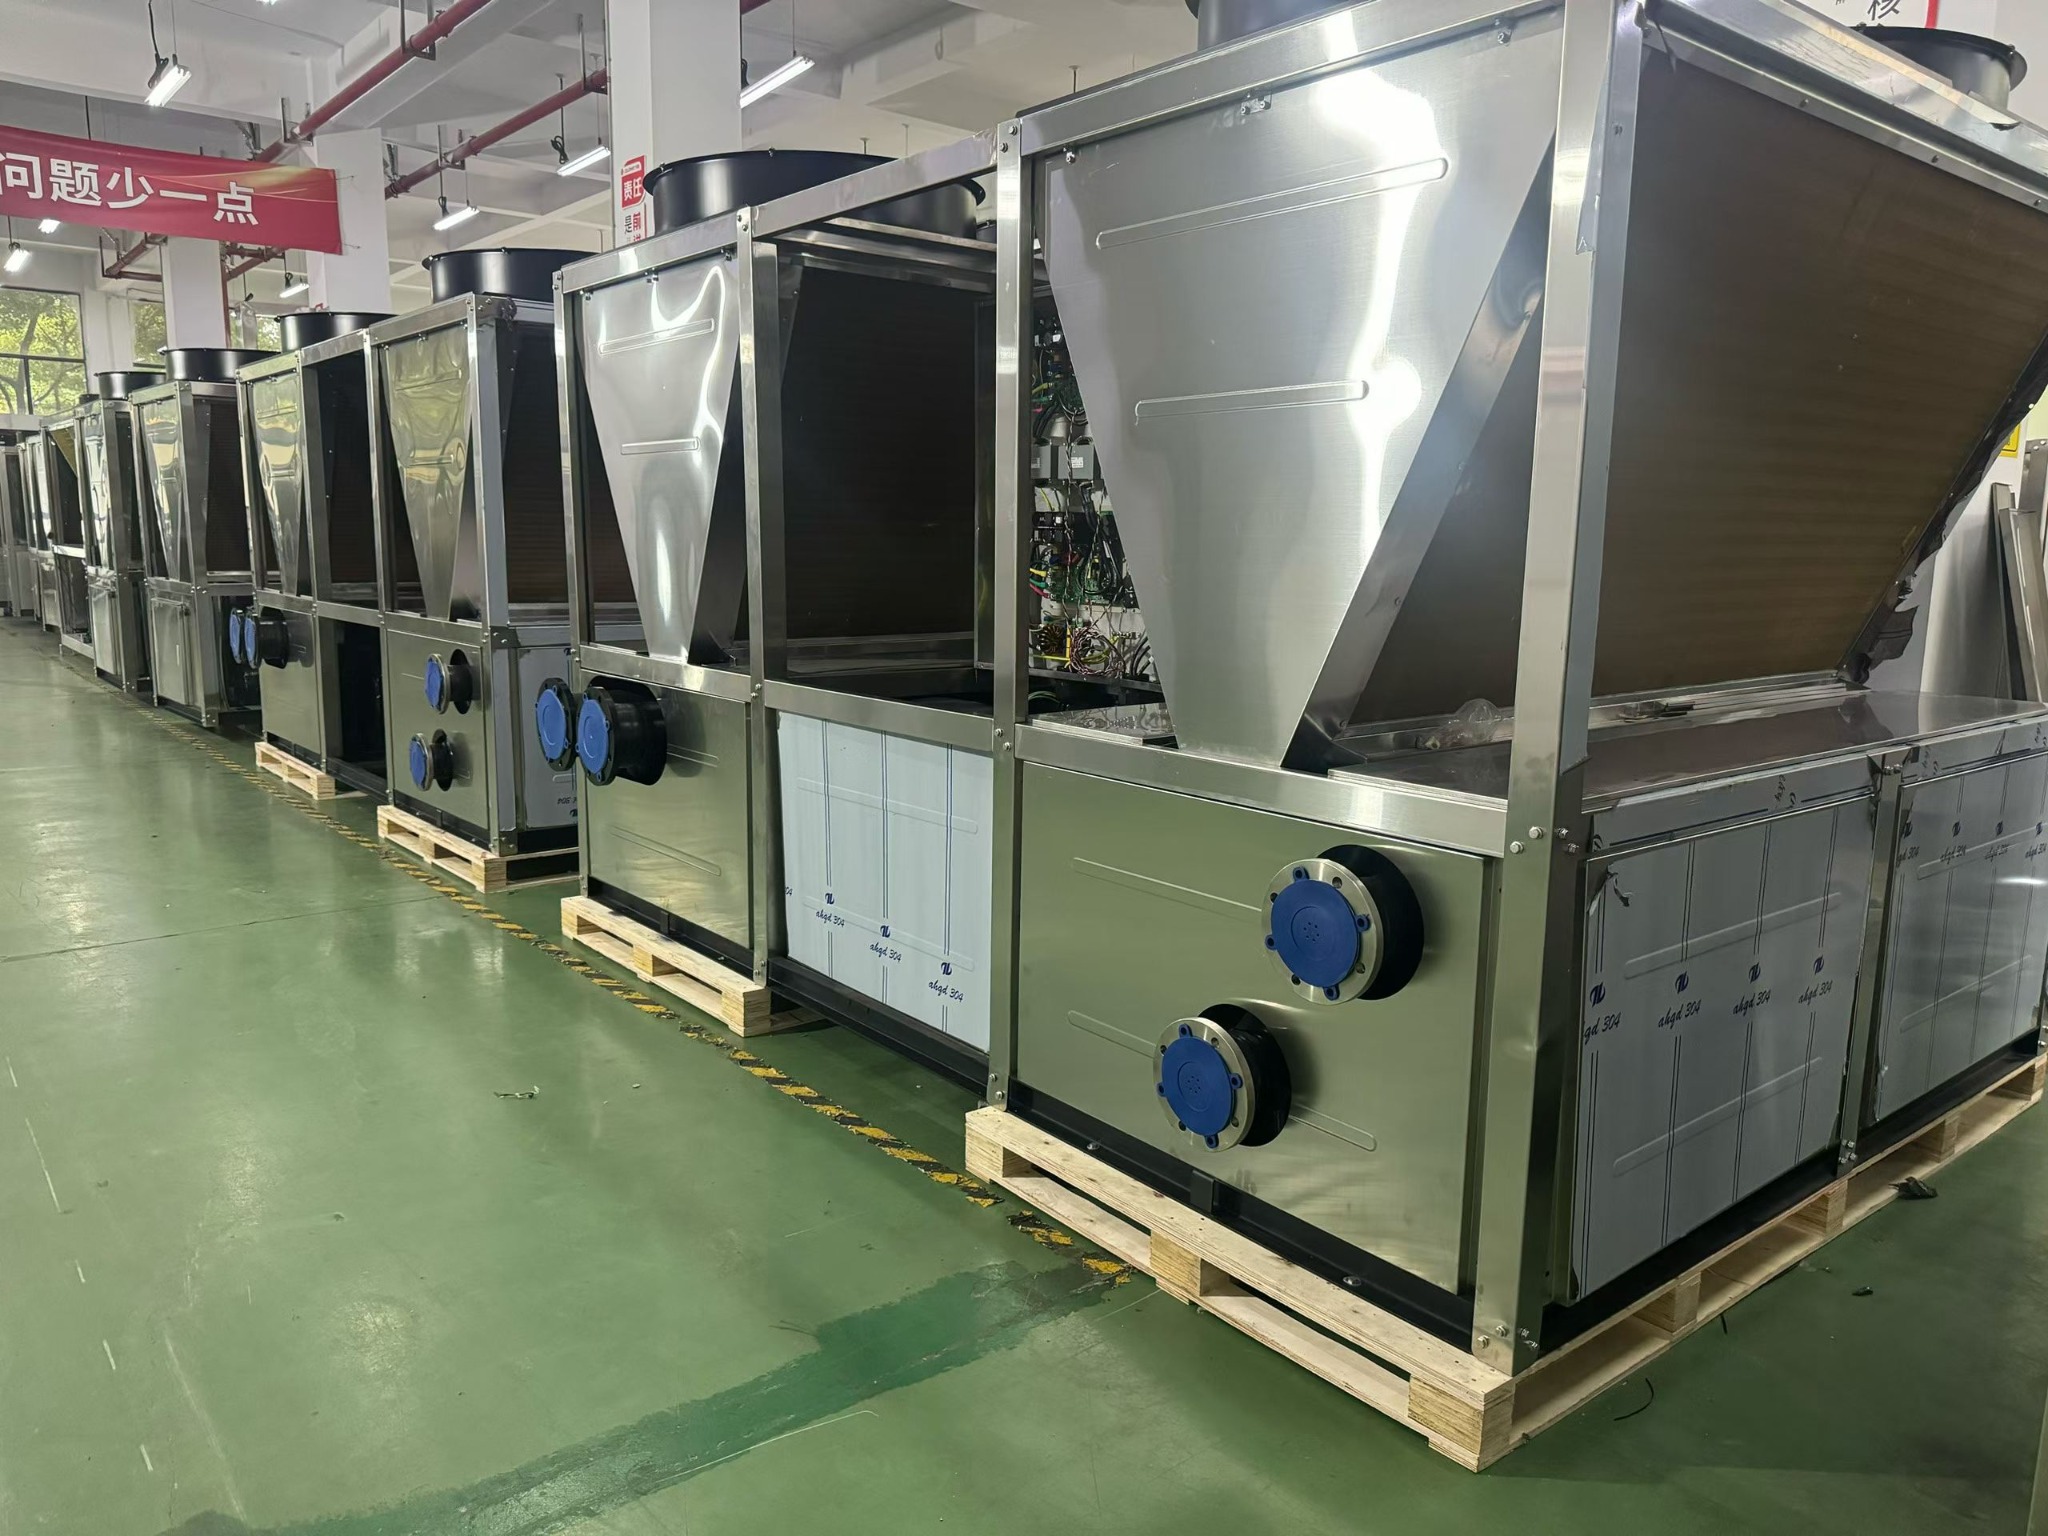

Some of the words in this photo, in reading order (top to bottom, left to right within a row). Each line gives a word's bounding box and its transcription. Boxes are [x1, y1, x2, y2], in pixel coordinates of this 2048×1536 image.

[0, 152, 259, 226] 问题少一点
[624, 177, 642, 201] 责任
[1658, 1007, 1684, 1029] ahgd
[1685, 1000, 1702, 1018] 304
[1732, 996, 1755, 1015] ahgd
[1755, 989, 1772, 1006] 304
[1602, 1012, 1622, 1032] 304
